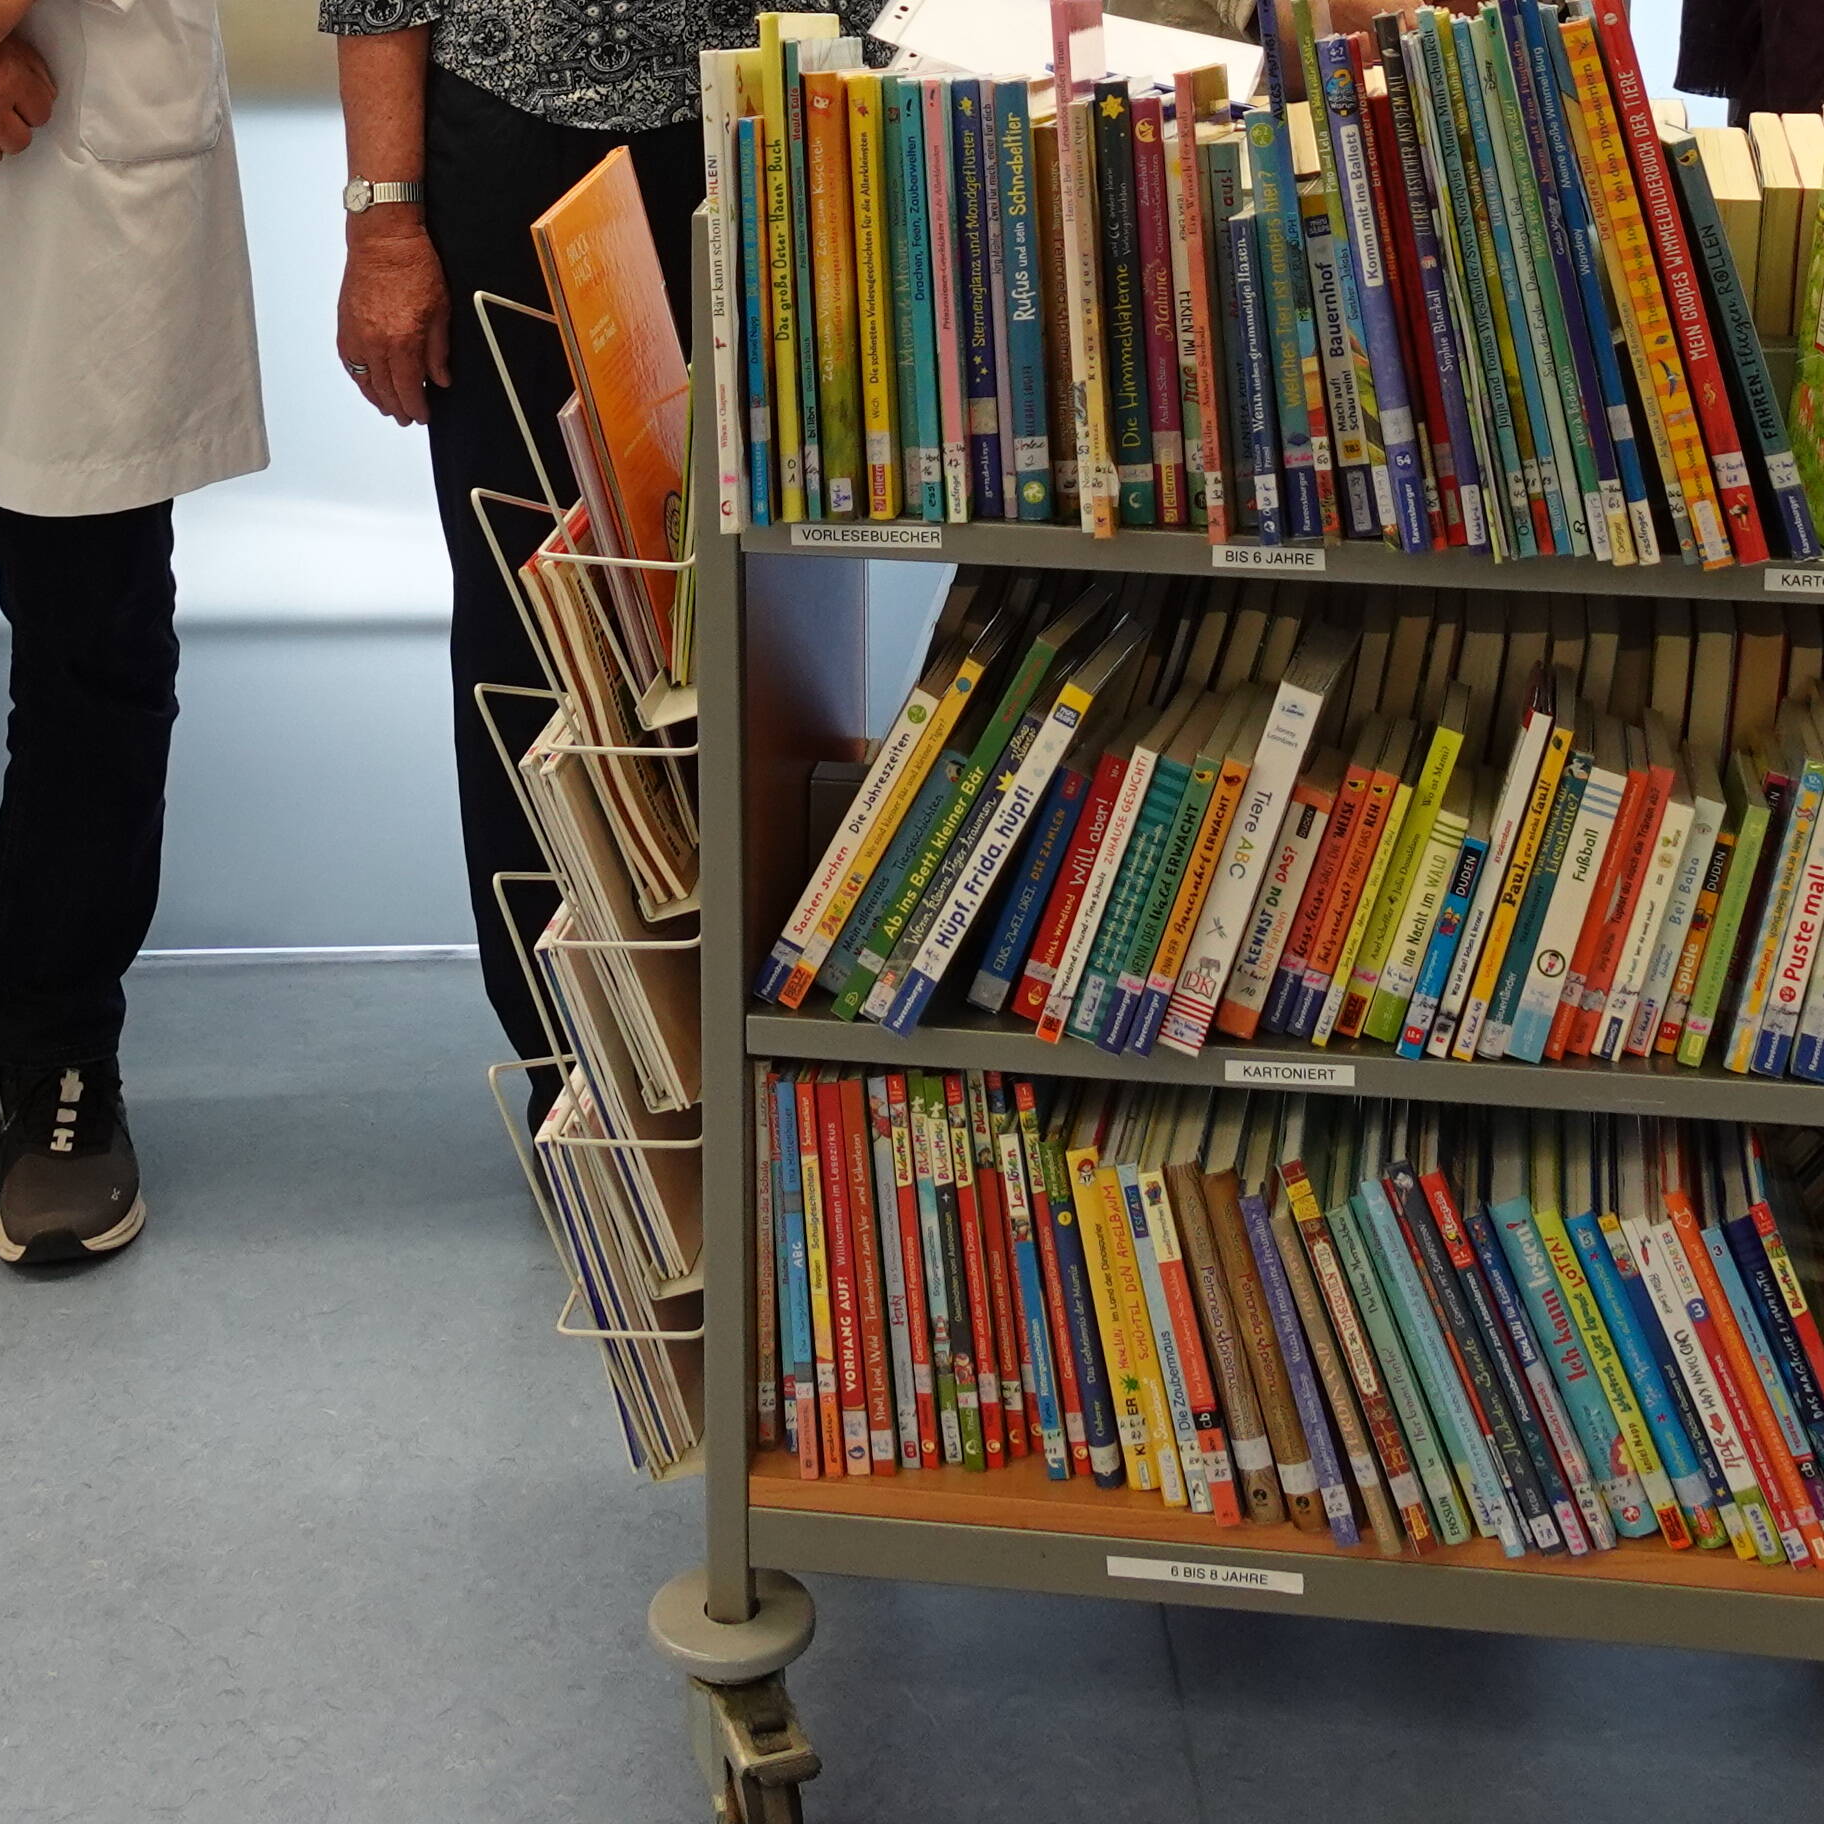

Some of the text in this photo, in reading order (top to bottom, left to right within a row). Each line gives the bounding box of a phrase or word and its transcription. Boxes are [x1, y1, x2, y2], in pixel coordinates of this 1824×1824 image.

[1616, 68, 1642, 109] TIERE
[1629, 111, 1650, 138] DER
[704, 154, 725, 316] Bär kann schon ZÄHLEN!
[905, 135, 926, 301] Drachen, Feen, Zauberwelten
[960, 128, 986, 347] Sternenglanz und Mondgeflüster
[1001, 111, 1037, 320] Rufus und sein Schnabeltier
[1343, 131, 1380, 279] Komm mit ins Ballett
[1635, 139, 1684, 269] WIMMELBILDERBUCH
[1108, 263, 1141, 448] Die Himmelslaterne
[1315, 260, 1344, 358] Bauernhof
[1682, 323, 1709, 361] MEIN
[802, 529, 940, 545] VORLESEBUECHER
[1296, 470, 1313, 531] Ravensburger
[1225, 550, 1315, 566] BIS 6 JAHRE
[846, 730, 913, 834] Die Jahreszeiten
[880, 763, 986, 939] Ab ins Bett, kleiner Bär
[931, 784, 1038, 951] Hüpf, Frida, hüpf!
[1227, 788, 1272, 880] Tiere ABC
[1571, 827, 1599, 882] Fußball
[791, 844, 850, 936] Sachen suchen
[1781, 918, 1816, 982] Puste
[1242, 1066, 1336, 1081] KARTONIERT
[837, 1275, 857, 1391] VORHANG AUF!
[1502, 1215, 1589, 1383] Ich kann lesen!
[1170, 1565, 1269, 1586] 6 BIS 8 JAHRE
